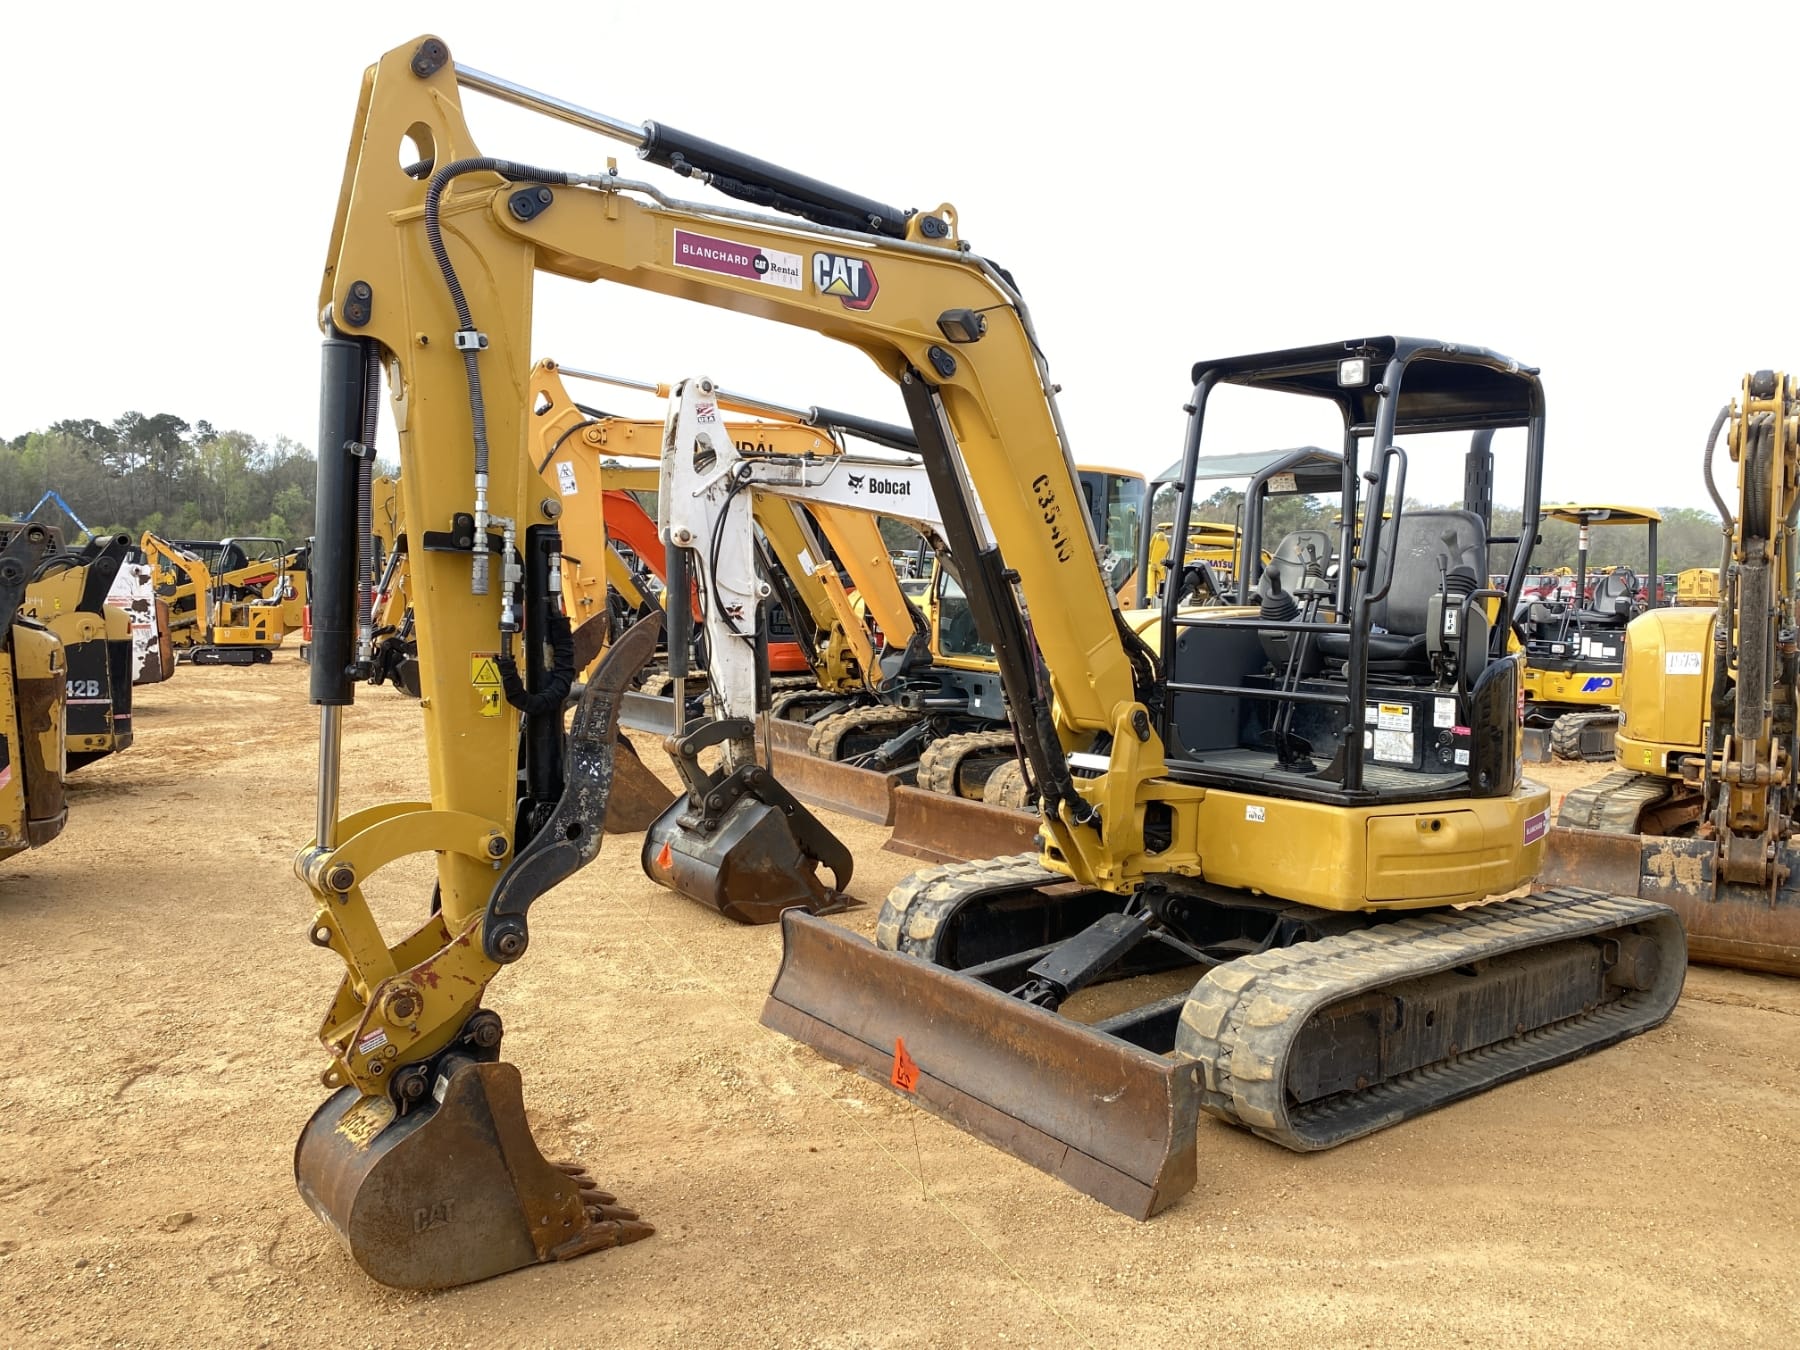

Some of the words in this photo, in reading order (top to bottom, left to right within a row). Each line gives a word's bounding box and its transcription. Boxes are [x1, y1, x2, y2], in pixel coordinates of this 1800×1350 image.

[682, 243, 749, 266] BLANCHARD
[754, 259, 766, 270] CAT
[770, 262, 799, 277] Rental
[812, 252, 863, 297] CAT
[869, 478, 911, 496] Bobcat
[414, 1198, 455, 1233] CAT
